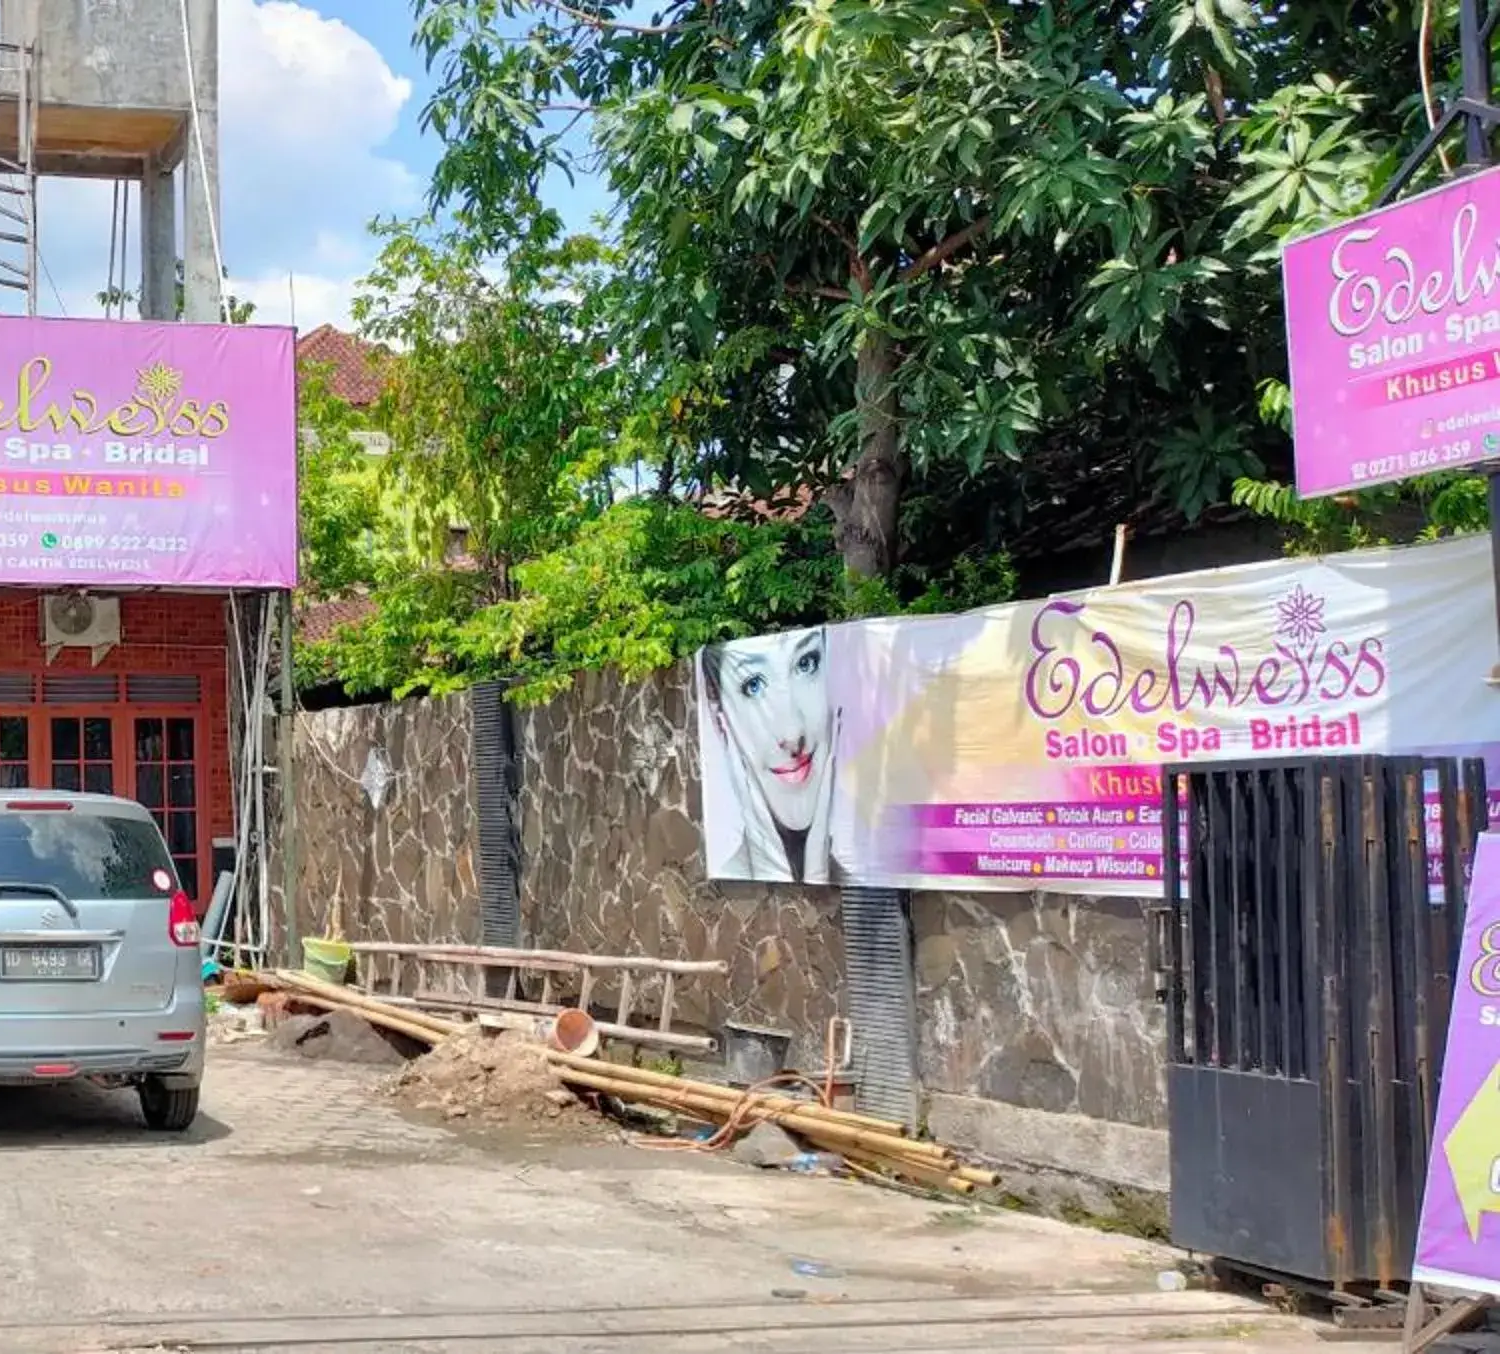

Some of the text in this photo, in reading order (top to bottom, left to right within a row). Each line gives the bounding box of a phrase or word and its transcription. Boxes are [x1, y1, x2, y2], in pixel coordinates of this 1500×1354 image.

[1349, 309, 1500, 370] Salon Spa
[1386, 361, 1486, 401] Khusus
[3, 436, 72, 464] Spa
[104, 441, 209, 466] Bridal
[62, 474, 187, 498] Wanita
[1025, 599, 1386, 718] Edelweiss
[1045, 712, 1362, 758] Salon Spa Bridal
[955, 808, 990, 824] Facial
[992, 807, 1044, 824] Galvanic
[1055, 807, 1088, 824] Totok
[1092, 807, 1122, 823] Aura
[1096, 856, 1145, 874] Wisuda
